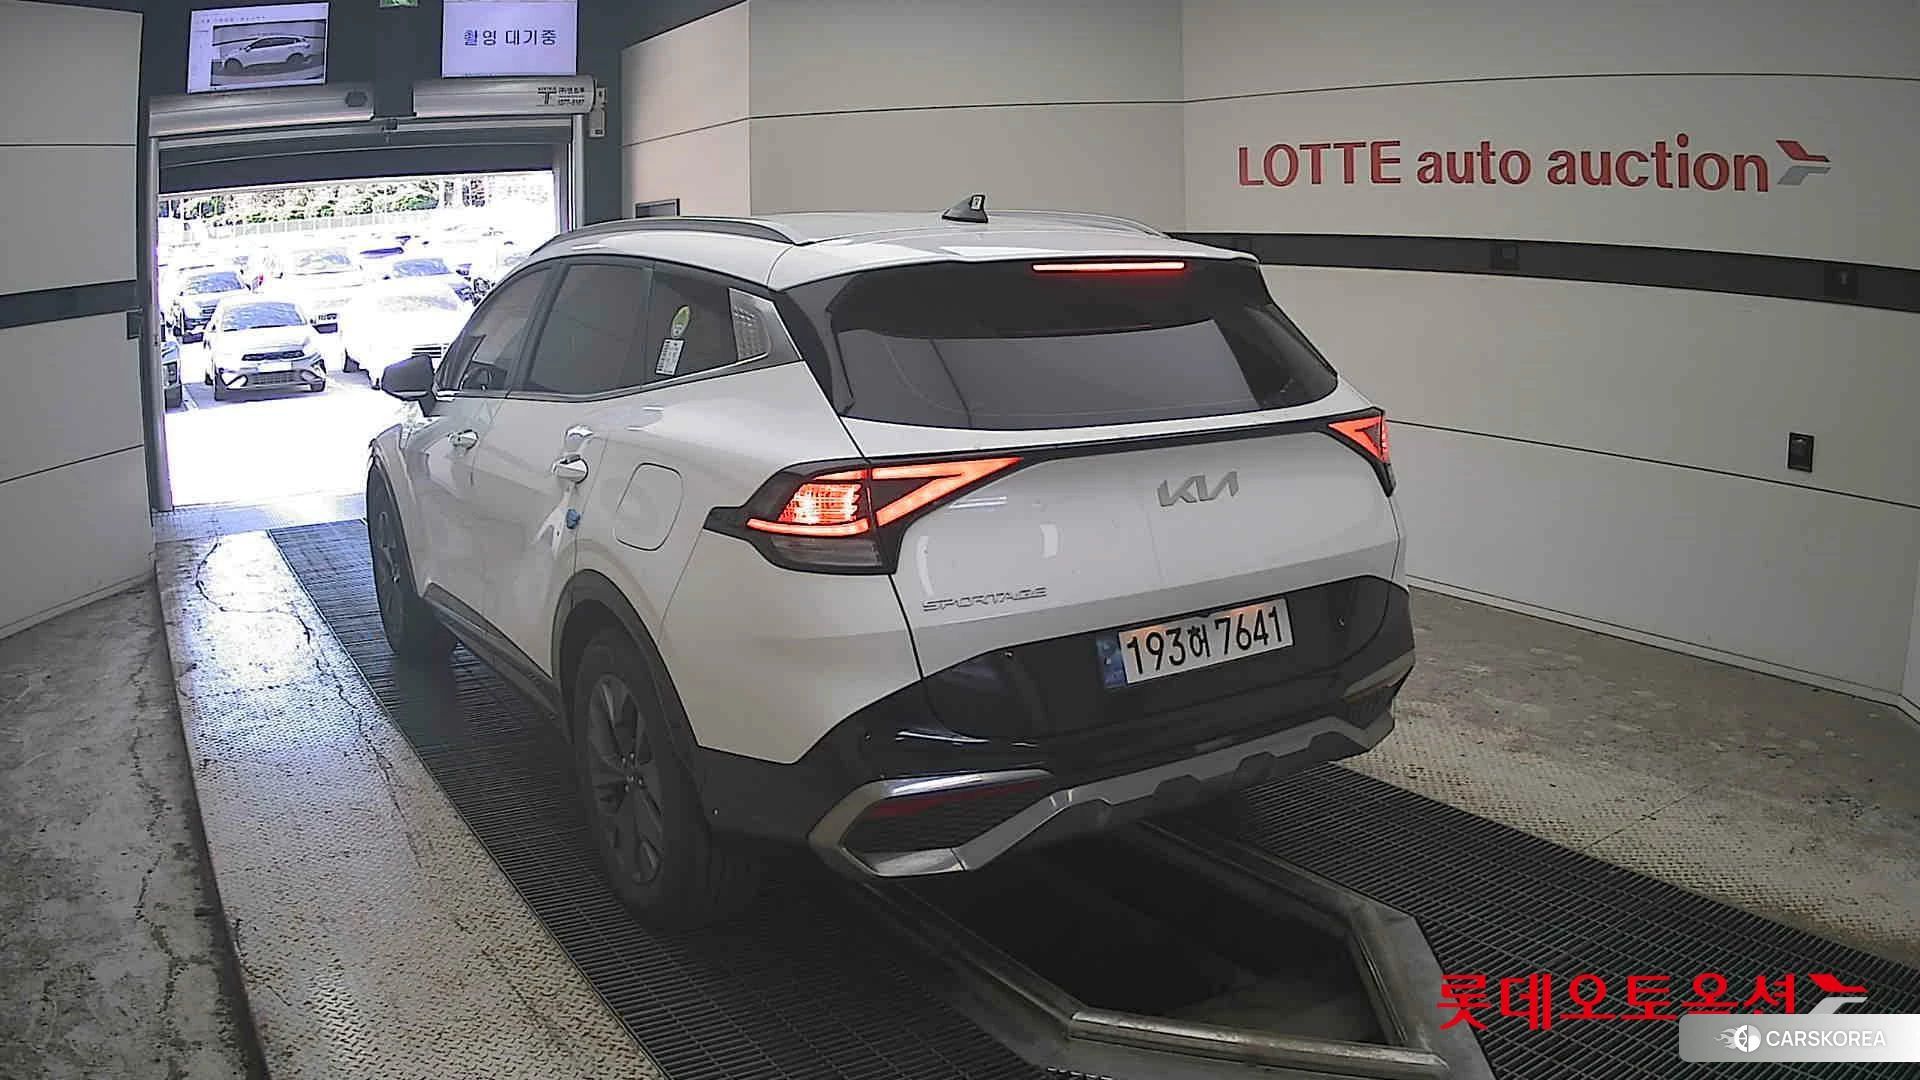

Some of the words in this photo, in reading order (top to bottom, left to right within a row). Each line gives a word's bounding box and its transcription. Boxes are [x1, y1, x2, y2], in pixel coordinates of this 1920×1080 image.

[505, 29, 557, 46] 대기중
[1238, 141, 1401, 187] LOTTE
[1416, 141, 1532, 186] auto
[1547, 133, 1769, 193] auction
[1157, 471, 1239, 507] KIA
[922, 587, 1047, 612] SPORTAGE
[1214, 605, 1283, 655] 7641
